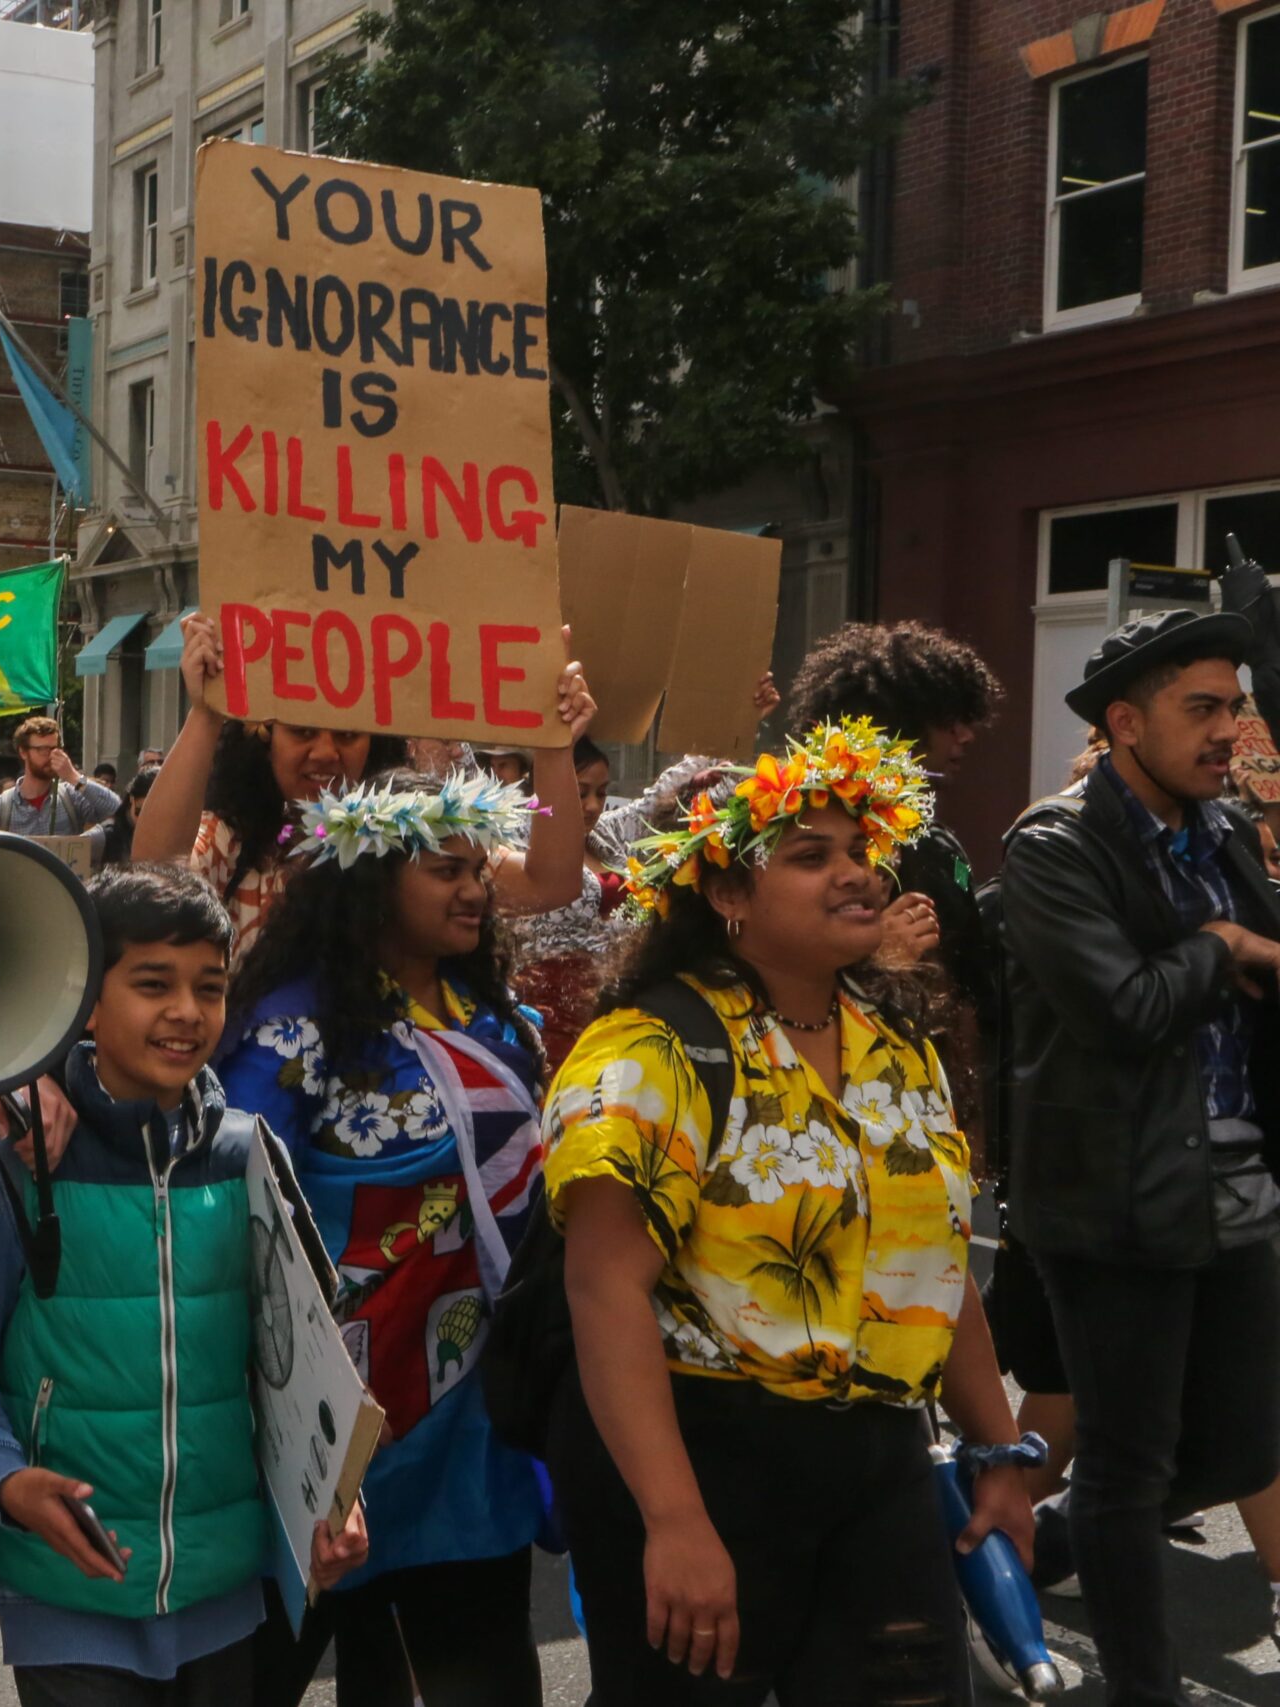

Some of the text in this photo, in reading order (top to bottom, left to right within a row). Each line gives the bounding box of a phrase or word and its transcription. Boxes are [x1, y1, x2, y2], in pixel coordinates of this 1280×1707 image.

[251, 167, 492, 271] YOUR
[203, 257, 548, 380] IGNORANCE
[322, 369, 397, 437] IS
[206, 421, 547, 547] KILLING
[312, 534, 420, 598] MY
[220, 603, 543, 728] PEOPLE
